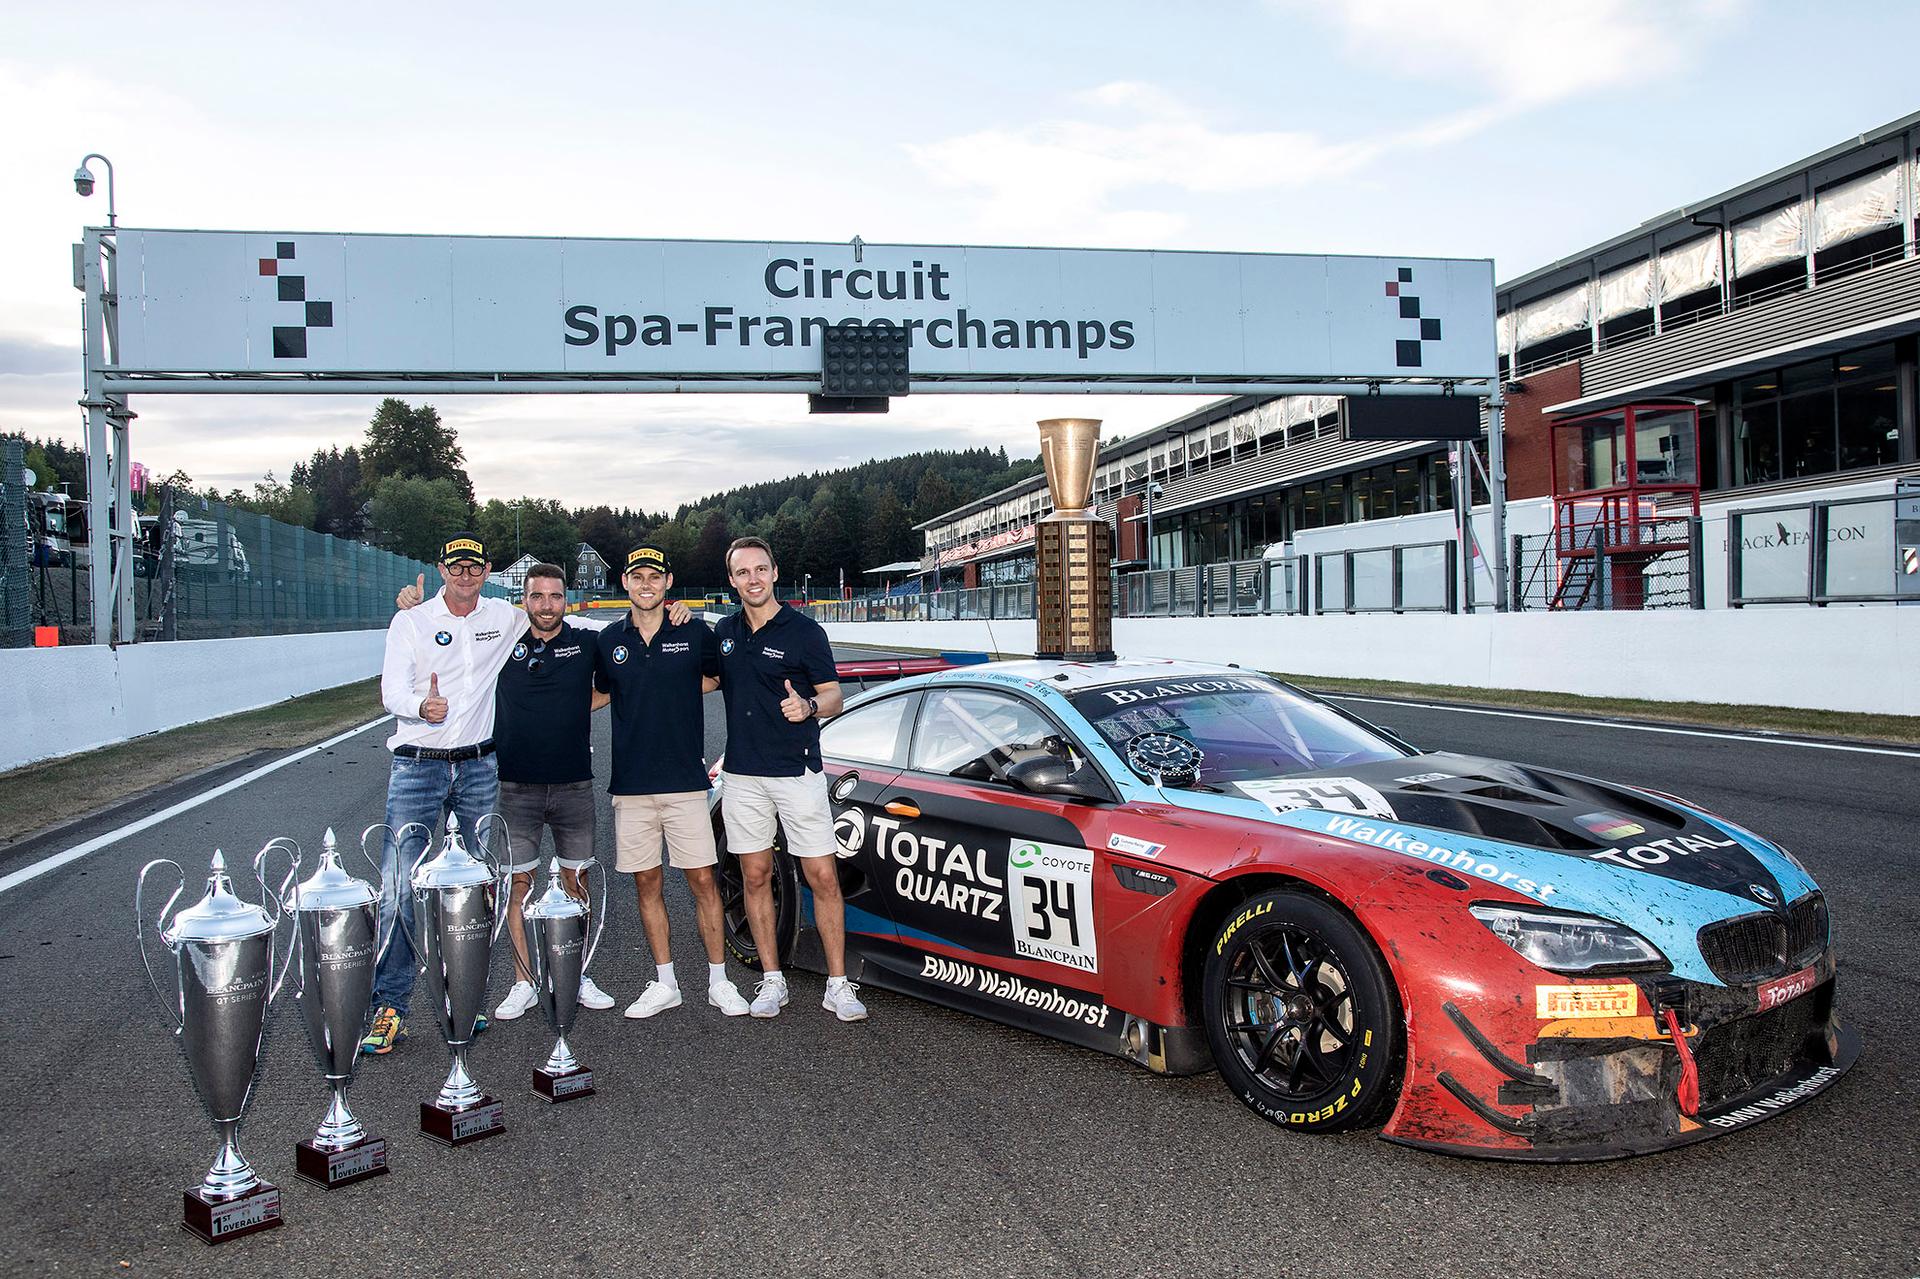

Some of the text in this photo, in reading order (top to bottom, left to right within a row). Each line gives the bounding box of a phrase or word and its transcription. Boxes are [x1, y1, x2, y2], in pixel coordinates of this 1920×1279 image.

[763, 258, 950, 301] Circuit
[564, 305, 1135, 359] Spa-Franrchamps
[1793, 525, 1866, 545] FACON
[1100, 680, 1274, 706] BLANCPAIN
[1269, 785, 1368, 810] 34
[872, 815, 1003, 888] TOTAL
[1042, 857, 1091, 873] COYOTE
[1325, 815, 1559, 900] Walkenhorst
[1588, 834, 1738, 870] TOTAL
[895, 868, 1003, 922] QUARTZ
[1023, 875, 1080, 947] 34
[1216, 901, 1274, 956] PIRELLI
[321, 946, 373, 961] BLANCPAIN
[1016, 939, 1096, 970] BLANCPAIN
[231, 992, 257, 1003] SERIES
[921, 955, 1109, 1028] BMW Walkenhorst
[1547, 991, 1629, 1012] PIRELLI
[1767, 979, 1808, 1006] TOTAL
[1290, 1077, 1362, 1124] P ZERO
[1708, 1066, 1841, 1128] BMW Walkenhorst
[338, 1164, 370, 1179] OVERALL
[223, 1215, 263, 1232] OVERALL
